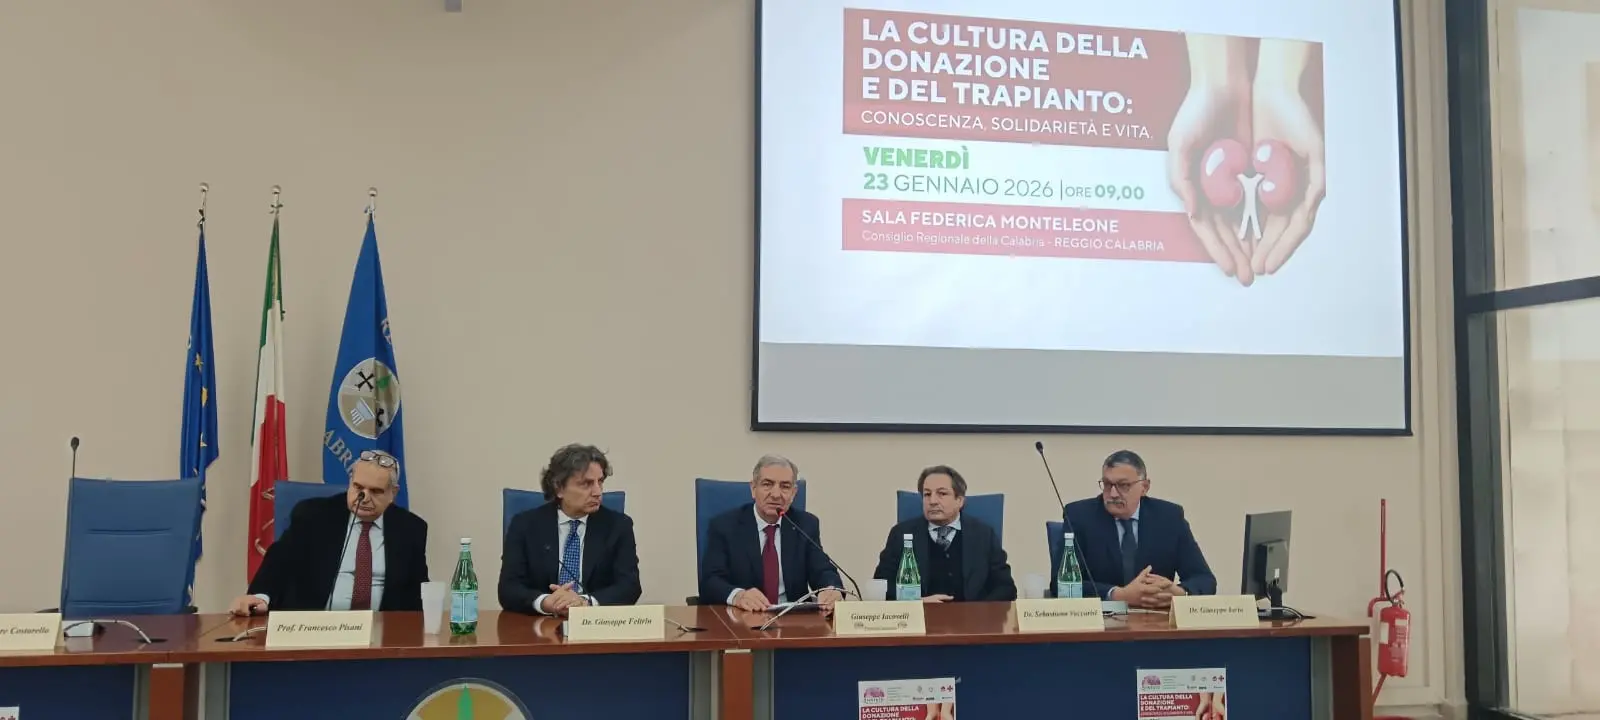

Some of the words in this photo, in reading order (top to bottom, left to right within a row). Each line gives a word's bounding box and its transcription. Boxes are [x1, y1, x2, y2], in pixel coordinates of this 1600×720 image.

[862, 18, 901, 42] LA
[907, 20, 1049, 53] CULTURA
[1056, 31, 1148, 60] DELLA
[862, 47, 1050, 81] DONAZIONE
[862, 76, 880, 99] E
[888, 78, 946, 104] DEL
[952, 81, 1133, 115] TRAPIANTO:
[861, 110, 987, 131] CONOSCENZA,
[991, 116, 1098, 136] SOLIDARIETÀ
[1102, 123, 1112, 136] E
[1114, 124, 1153, 139] VITA.
[863, 145, 969, 170] VENERDÌ
[863, 172, 889, 191] 23
[894, 174, 999, 196] GENNAIO
[1004, 178, 1054, 198] 2026
[1094, 184, 1145, 200] 09,00
[861, 209, 907, 225] SALA
[910, 211, 997, 229] FEDERICA
[1000, 215, 1119, 233] MONTELEONE
[861, 230, 914, 244] Consiglio
[916, 231, 970, 246] Regionale
[972, 233, 999, 246] della
[1000, 235, 1045, 248] Calabria
[1054, 238, 1103, 250] REGGIO
[1105, 239, 1165, 252] CALABRIA
[276, 623, 297, 633] Prof.
[298, 622, 337, 632] Francesco
[338, 621, 364, 631] Pisani
[594, 617, 627, 627] Giuseppe
